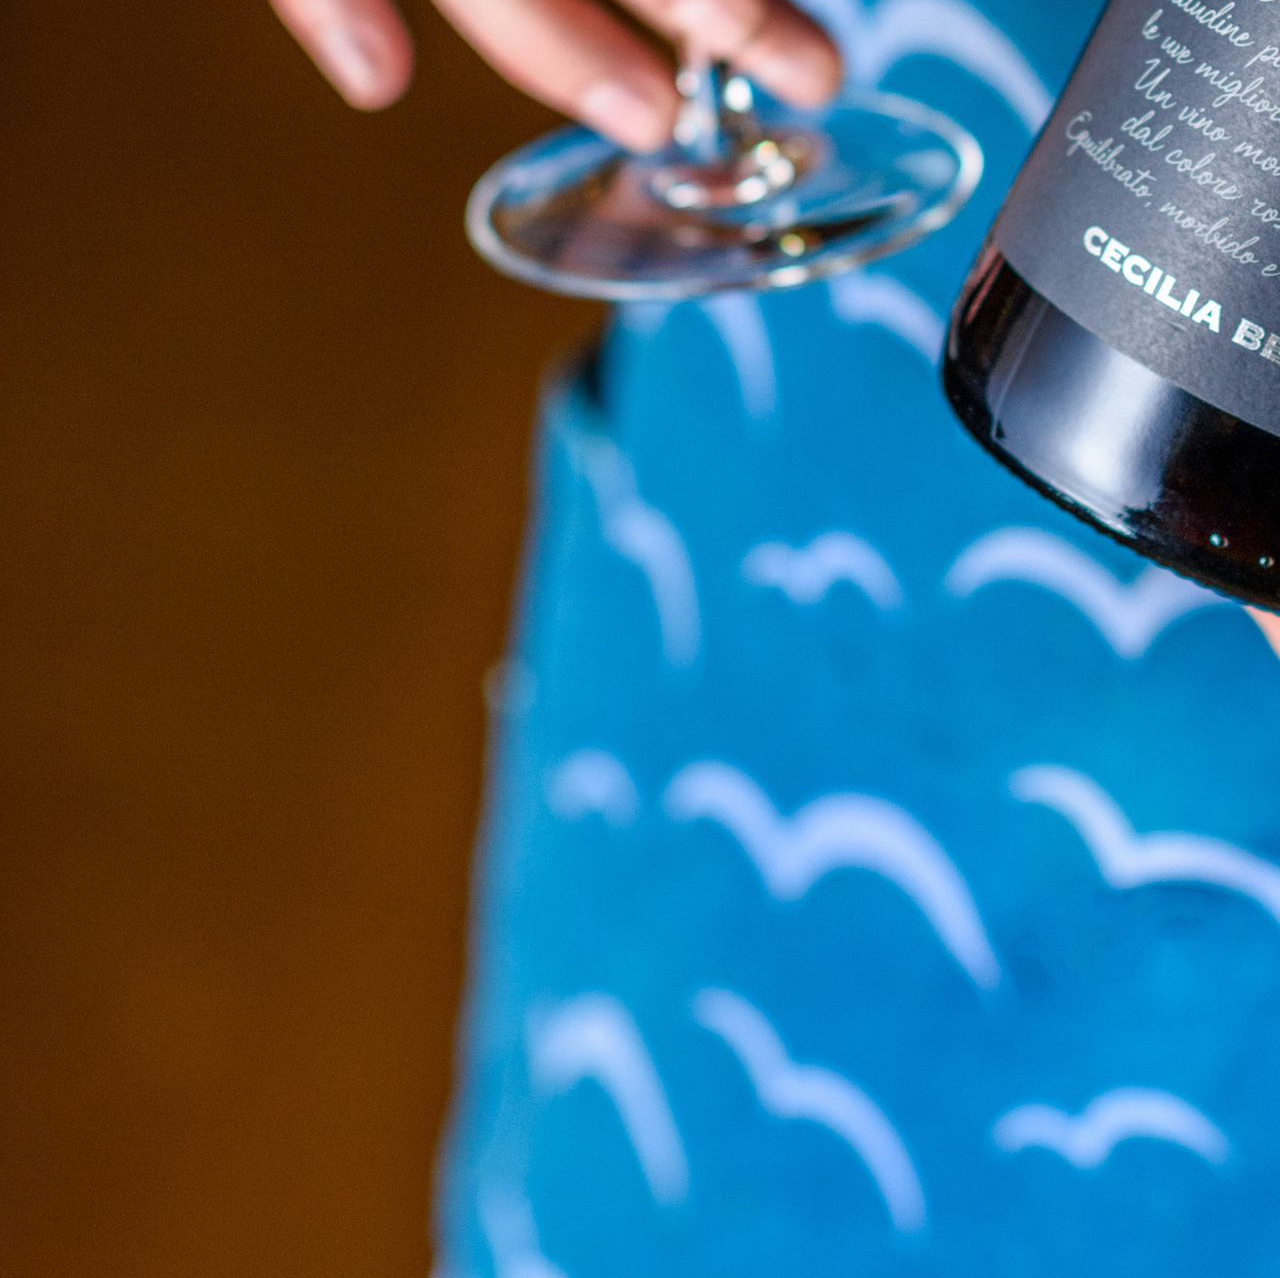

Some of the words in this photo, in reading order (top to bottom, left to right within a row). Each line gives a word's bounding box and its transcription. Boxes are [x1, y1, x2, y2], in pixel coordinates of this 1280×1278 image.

[1142, 8, 1162, 39] le
[1161, 36, 1193, 63] uve
[1134, 58, 1175, 108] Un
[1178, 106, 1229, 140] vino
[1120, 110, 1172, 150] dal
[1165, 151, 1242, 198] colore
[1081, 226, 1222, 333] CECILIA
[1159, 202, 1259, 263] morbido
[1261, 264, 1280, 275] e
